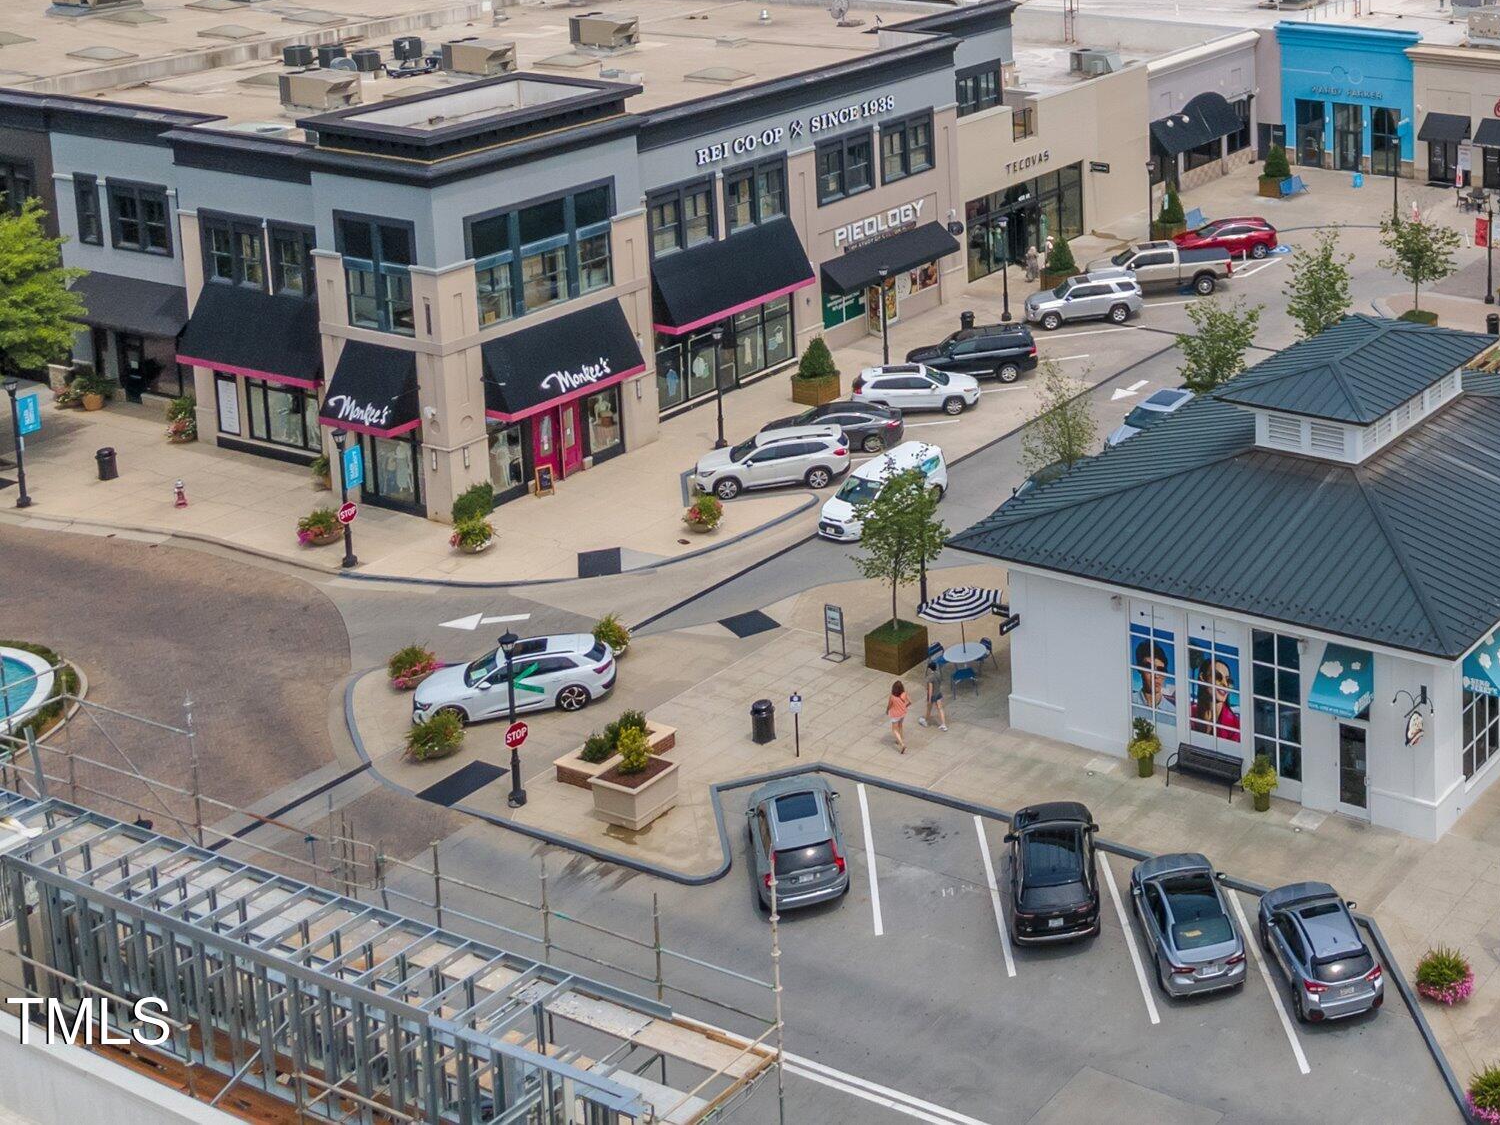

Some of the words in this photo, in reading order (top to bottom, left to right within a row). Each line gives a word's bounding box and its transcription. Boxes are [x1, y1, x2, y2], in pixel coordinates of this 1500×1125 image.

[696, 141, 730, 166] REI
[733, 126, 784, 155] CO-OP
[810, 105, 859, 133] SINCE
[861, 95, 895, 117] 1938
[1005, 150, 1050, 174] TECOVAS
[834, 199, 925, 248] PIEOLOGY
[540, 357, 611, 393] Monkee's
[328, 394, 392, 426] Monkee's
[340, 506, 356, 520] STOP
[506, 726, 527, 743] STOP
